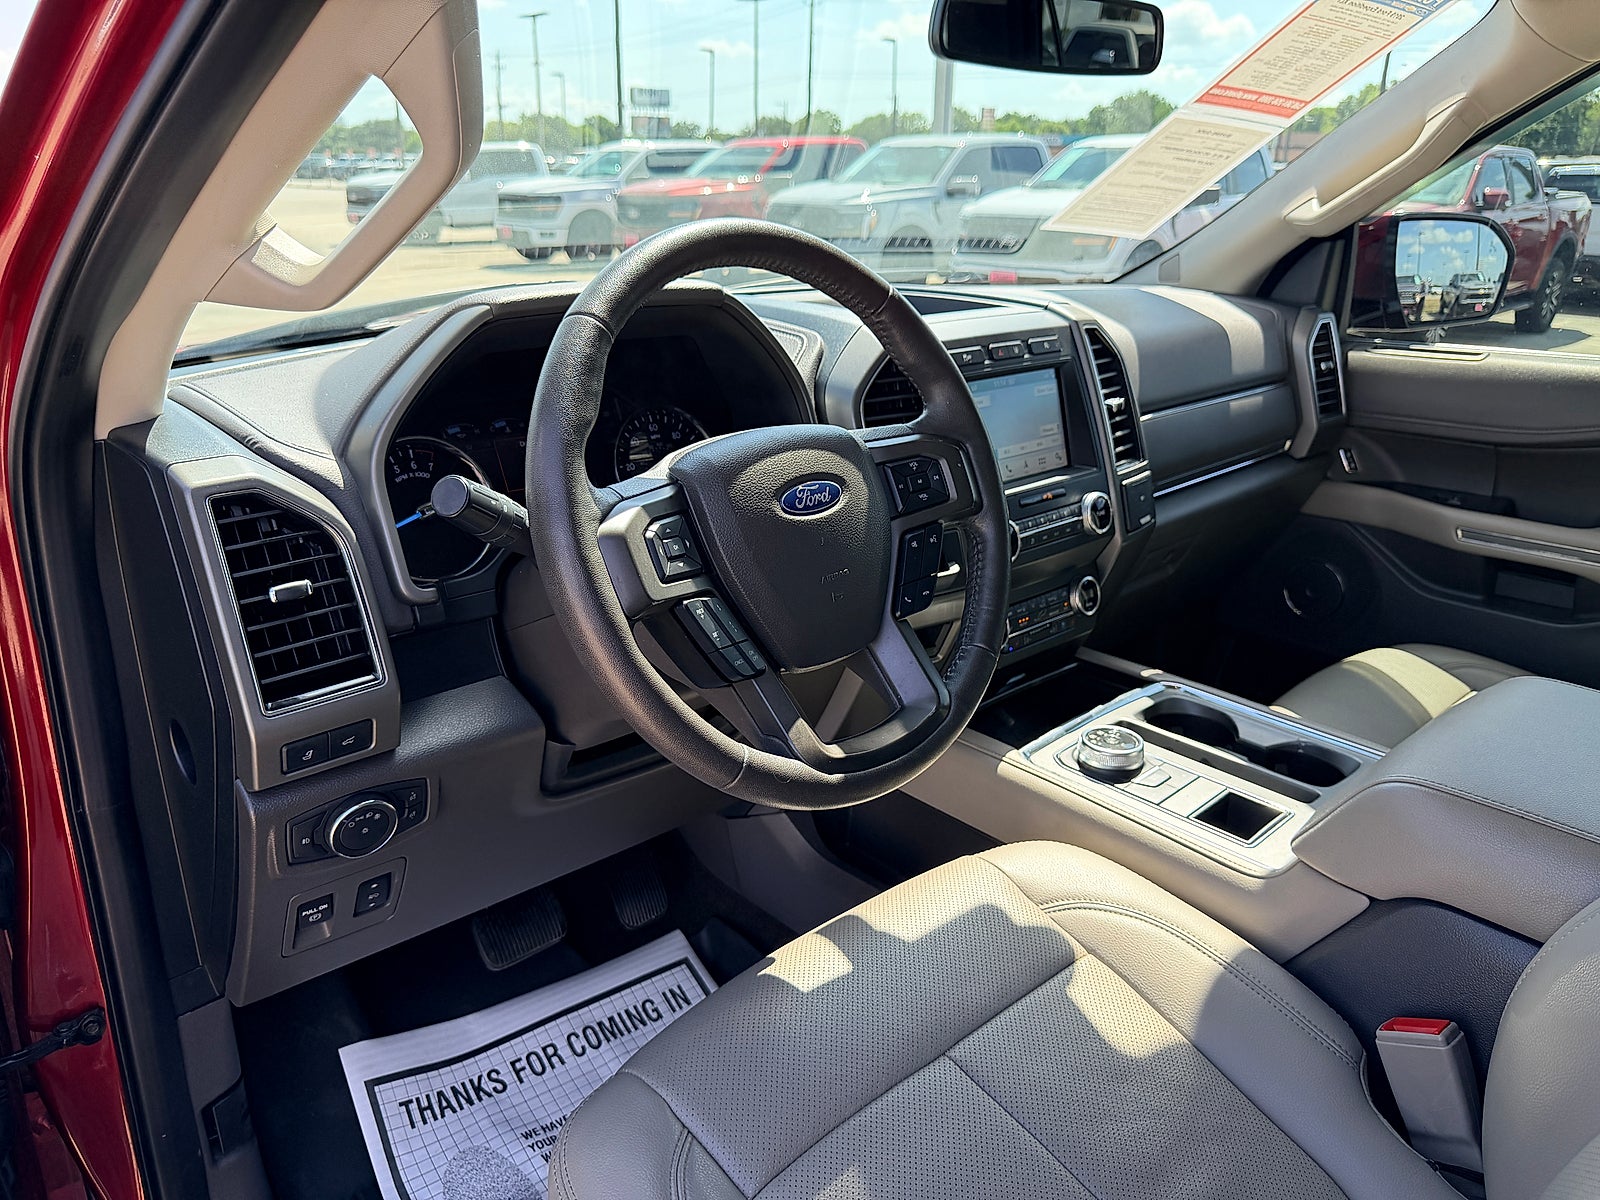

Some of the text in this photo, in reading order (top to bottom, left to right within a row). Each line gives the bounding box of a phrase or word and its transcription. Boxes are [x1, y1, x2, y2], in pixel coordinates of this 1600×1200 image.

[394, 464, 400, 474] 5
[410, 460, 417, 470] 6
[428, 462, 434, 471] 7
[795, 484, 832, 509] Ford
[302, 907, 318, 917] PULL
[398, 984, 692, 1130] THANKS FOR COMING IN
[520, 1127, 541, 1140] WE
